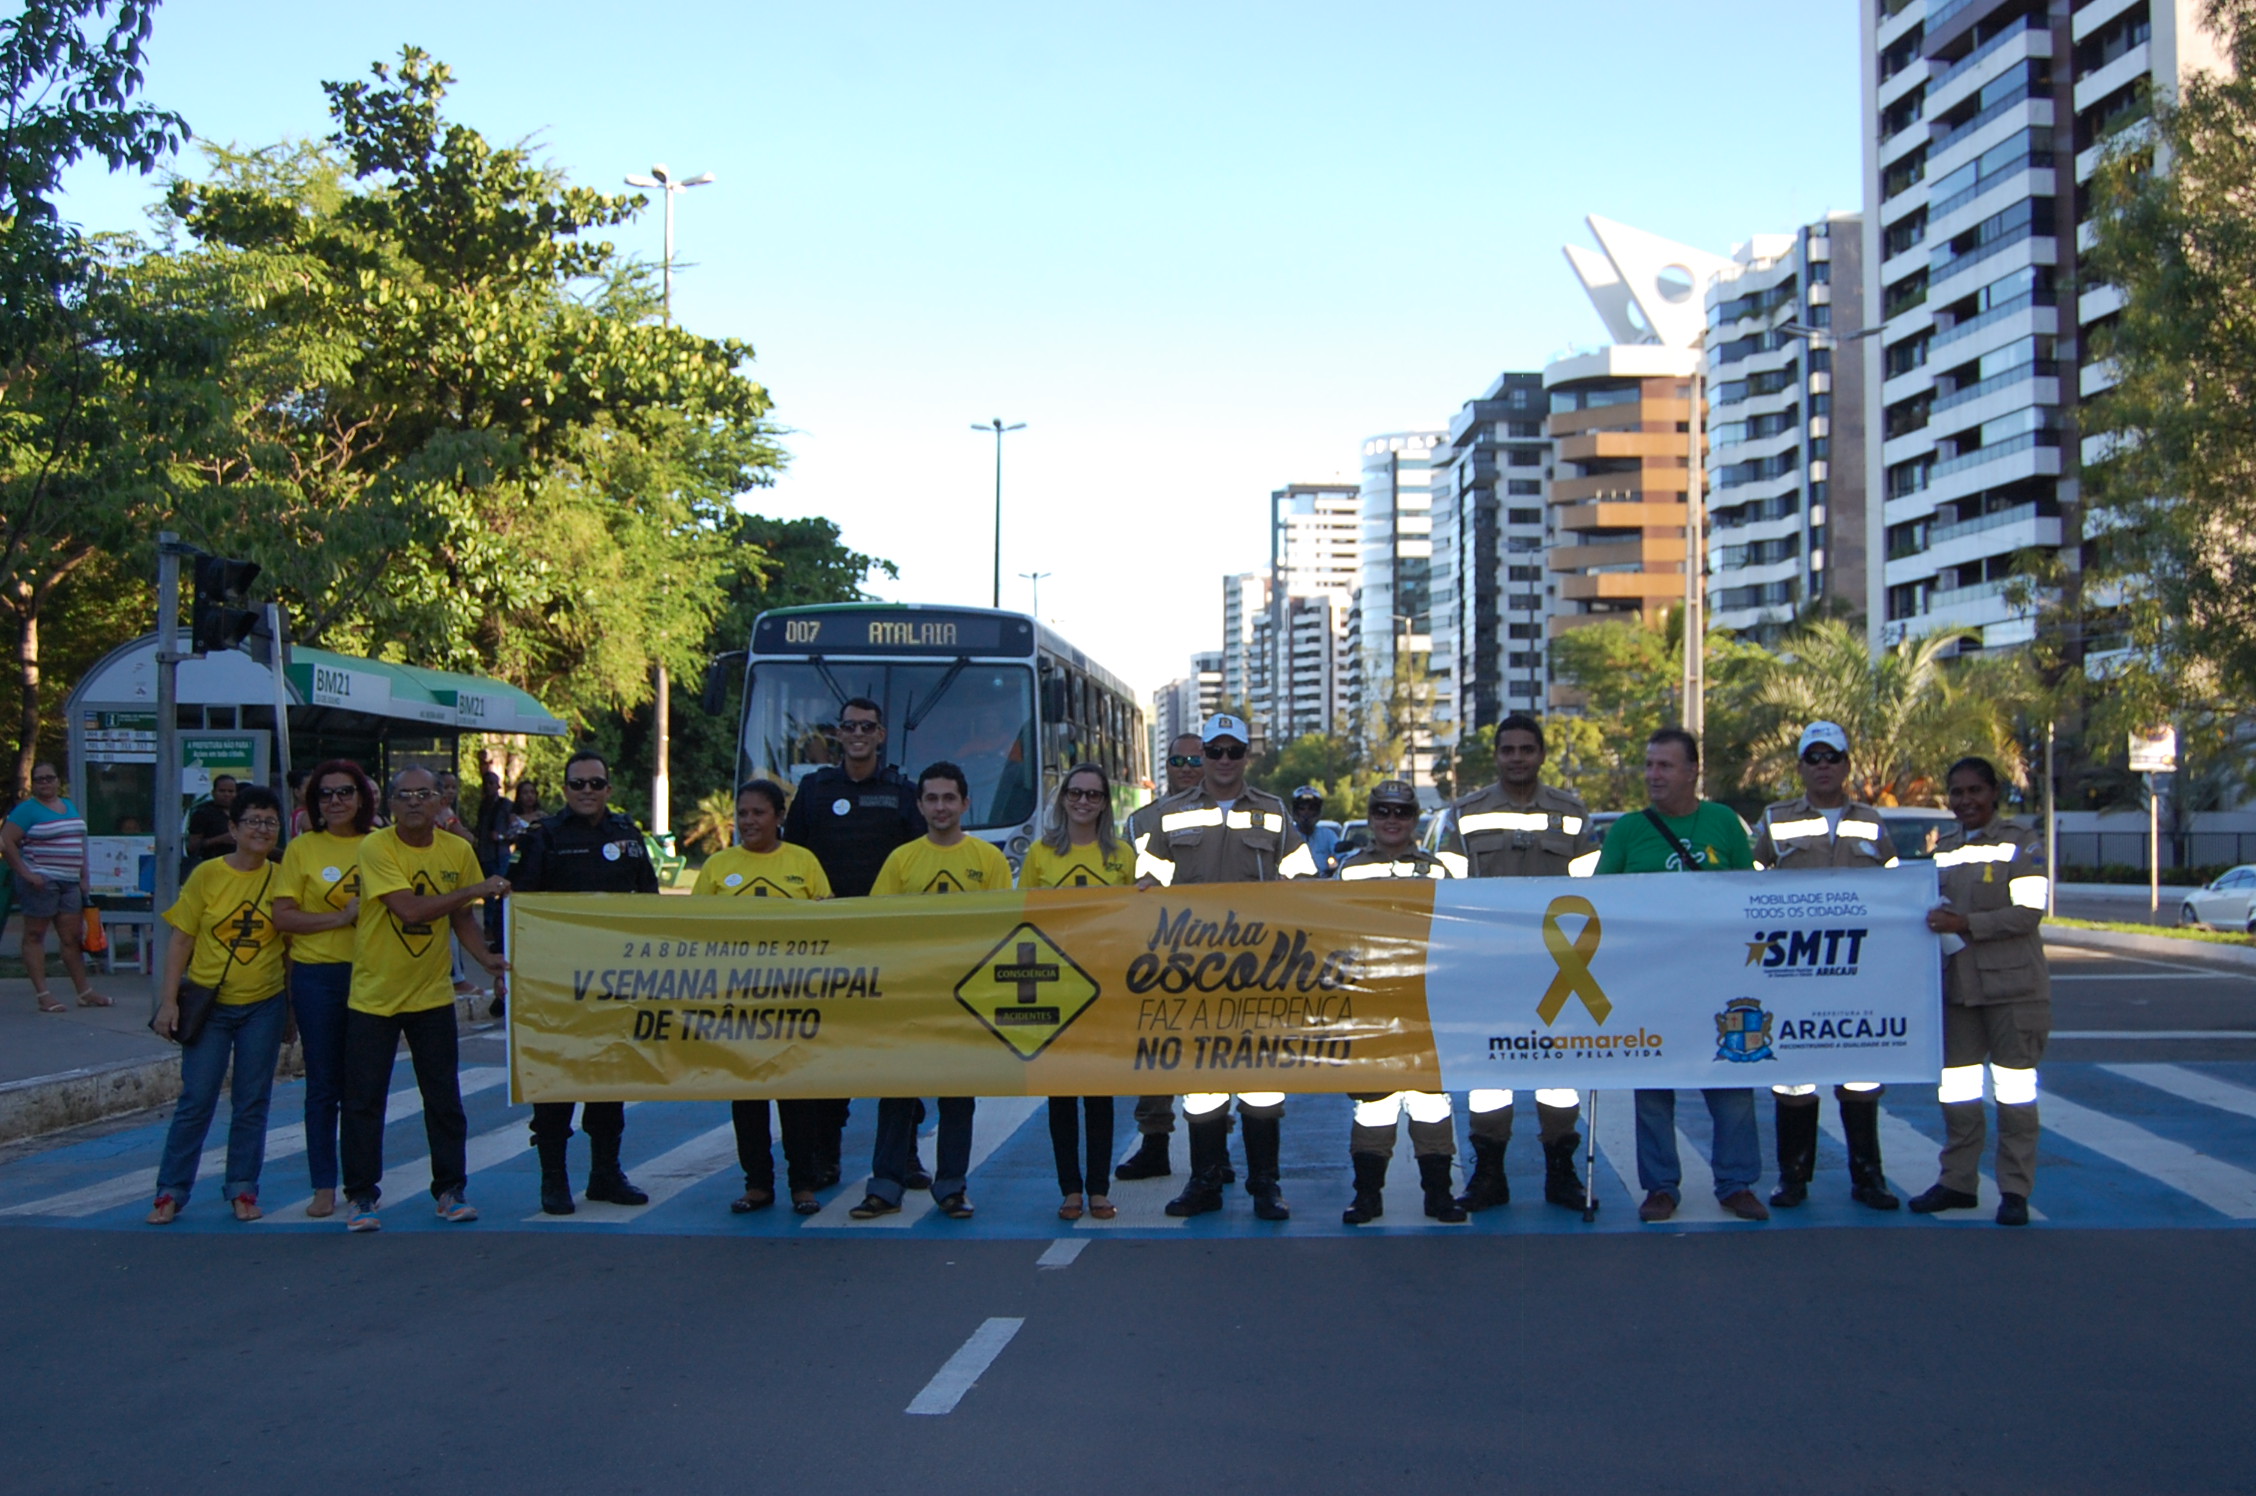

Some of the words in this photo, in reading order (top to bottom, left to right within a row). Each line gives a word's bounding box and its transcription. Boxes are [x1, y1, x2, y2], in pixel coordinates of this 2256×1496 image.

[785, 620, 821, 643] 007
[868, 621, 957, 645] ATALAIA
[316, 668, 351, 697] BM21
[458, 694, 485, 717] BM21
[1749, 893, 1823, 905] MOBILIDADE
[1825, 892, 1859, 902] PARA
[1744, 908, 1785, 919] TODOS
[1787, 907, 1805, 918] OS
[1807, 904, 1868, 917] CIDADÃOS
[1147, 907, 1268, 952] Minha
[623, 943, 634, 957] 2
[640, 943, 652, 957] A
[659, 942, 669, 957] 8
[676, 941, 699, 957] DE
[705, 941, 750, 957] MAIO
[757, 941, 779, 956] DE
[786, 940, 830, 956] 2017
[997, 968, 1057, 978] CONSCIÊNCIA
[1815, 967, 1859, 976] ARACAJU
[573, 970, 595, 1000] V
[597, 968, 718, 1000] SEMANA
[726, 967, 883, 999] MUNICIPAL
[633, 1009, 674, 1041] DE
[680, 1003, 821, 1041] TRÂNSITO
[1003, 1011, 1052, 1020] ACIDENTES
[1137, 998, 1187, 1031] FAZ
[1190, 998, 1210, 1031] A
[1779, 1017, 1907, 1040] ARACAJU
[1134, 1036, 1185, 1070] NO
[1194, 1029, 1350, 1069] TRÂNSITO
[1489, 1051, 1564, 1060] ATENÇÃO
[1576, 1050, 1613, 1058] PELA
[1624, 1049, 1662, 1057] VIDA
